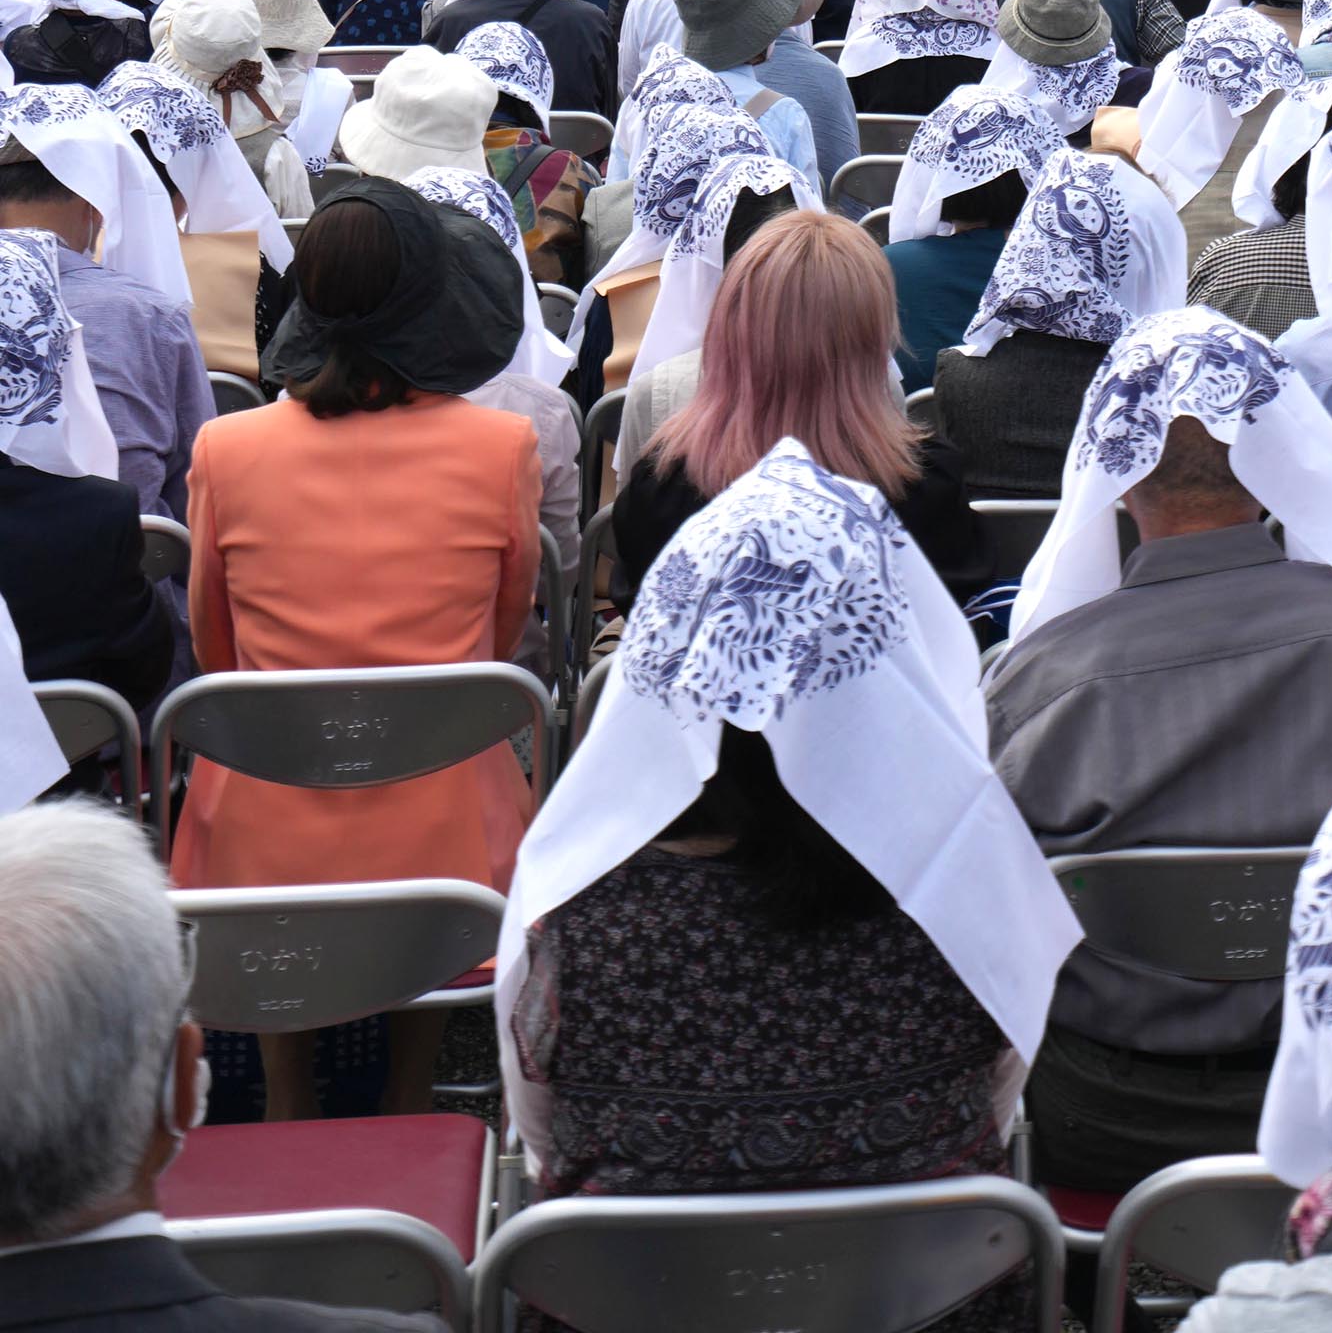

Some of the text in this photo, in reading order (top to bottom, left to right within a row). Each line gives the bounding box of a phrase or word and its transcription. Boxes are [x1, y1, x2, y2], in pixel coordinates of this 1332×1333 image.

[320, 716, 390, 740] ひかり
[1208, 896, 1286, 922] ひかり
[240, 945, 323, 972] ひかり
